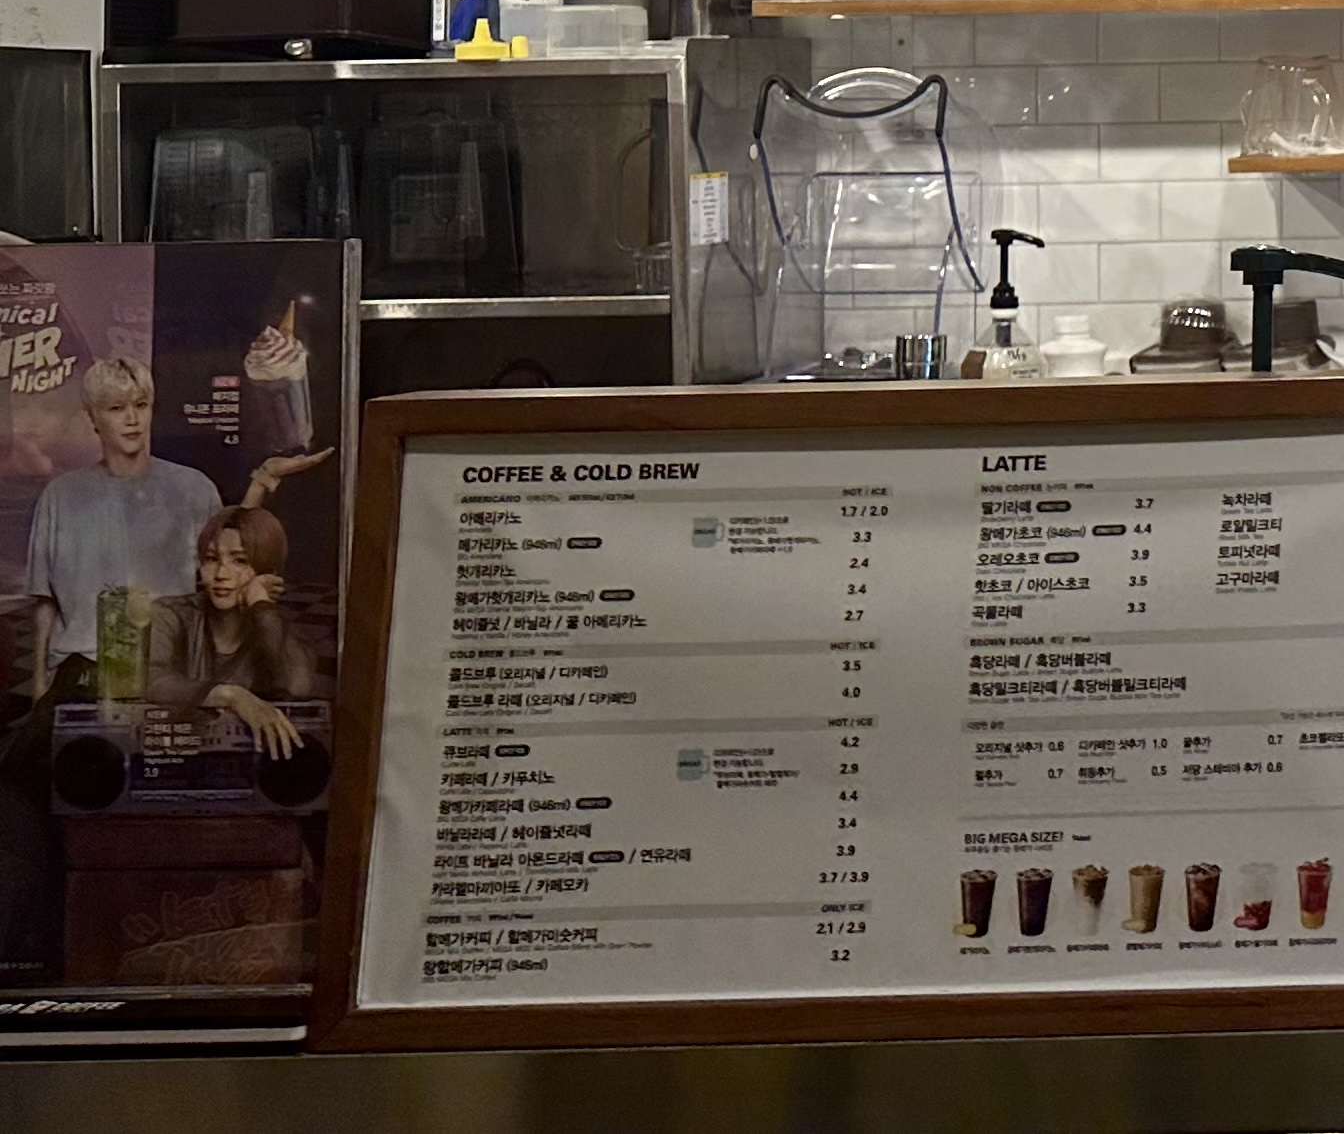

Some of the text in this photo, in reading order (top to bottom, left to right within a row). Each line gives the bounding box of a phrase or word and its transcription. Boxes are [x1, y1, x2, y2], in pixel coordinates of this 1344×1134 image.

[983, 455, 1046, 472] LATTE
[463, 463, 699, 483] COFFEE & COLD BREW
[965, 832, 1063, 844] BIG MEGA SIZE!
